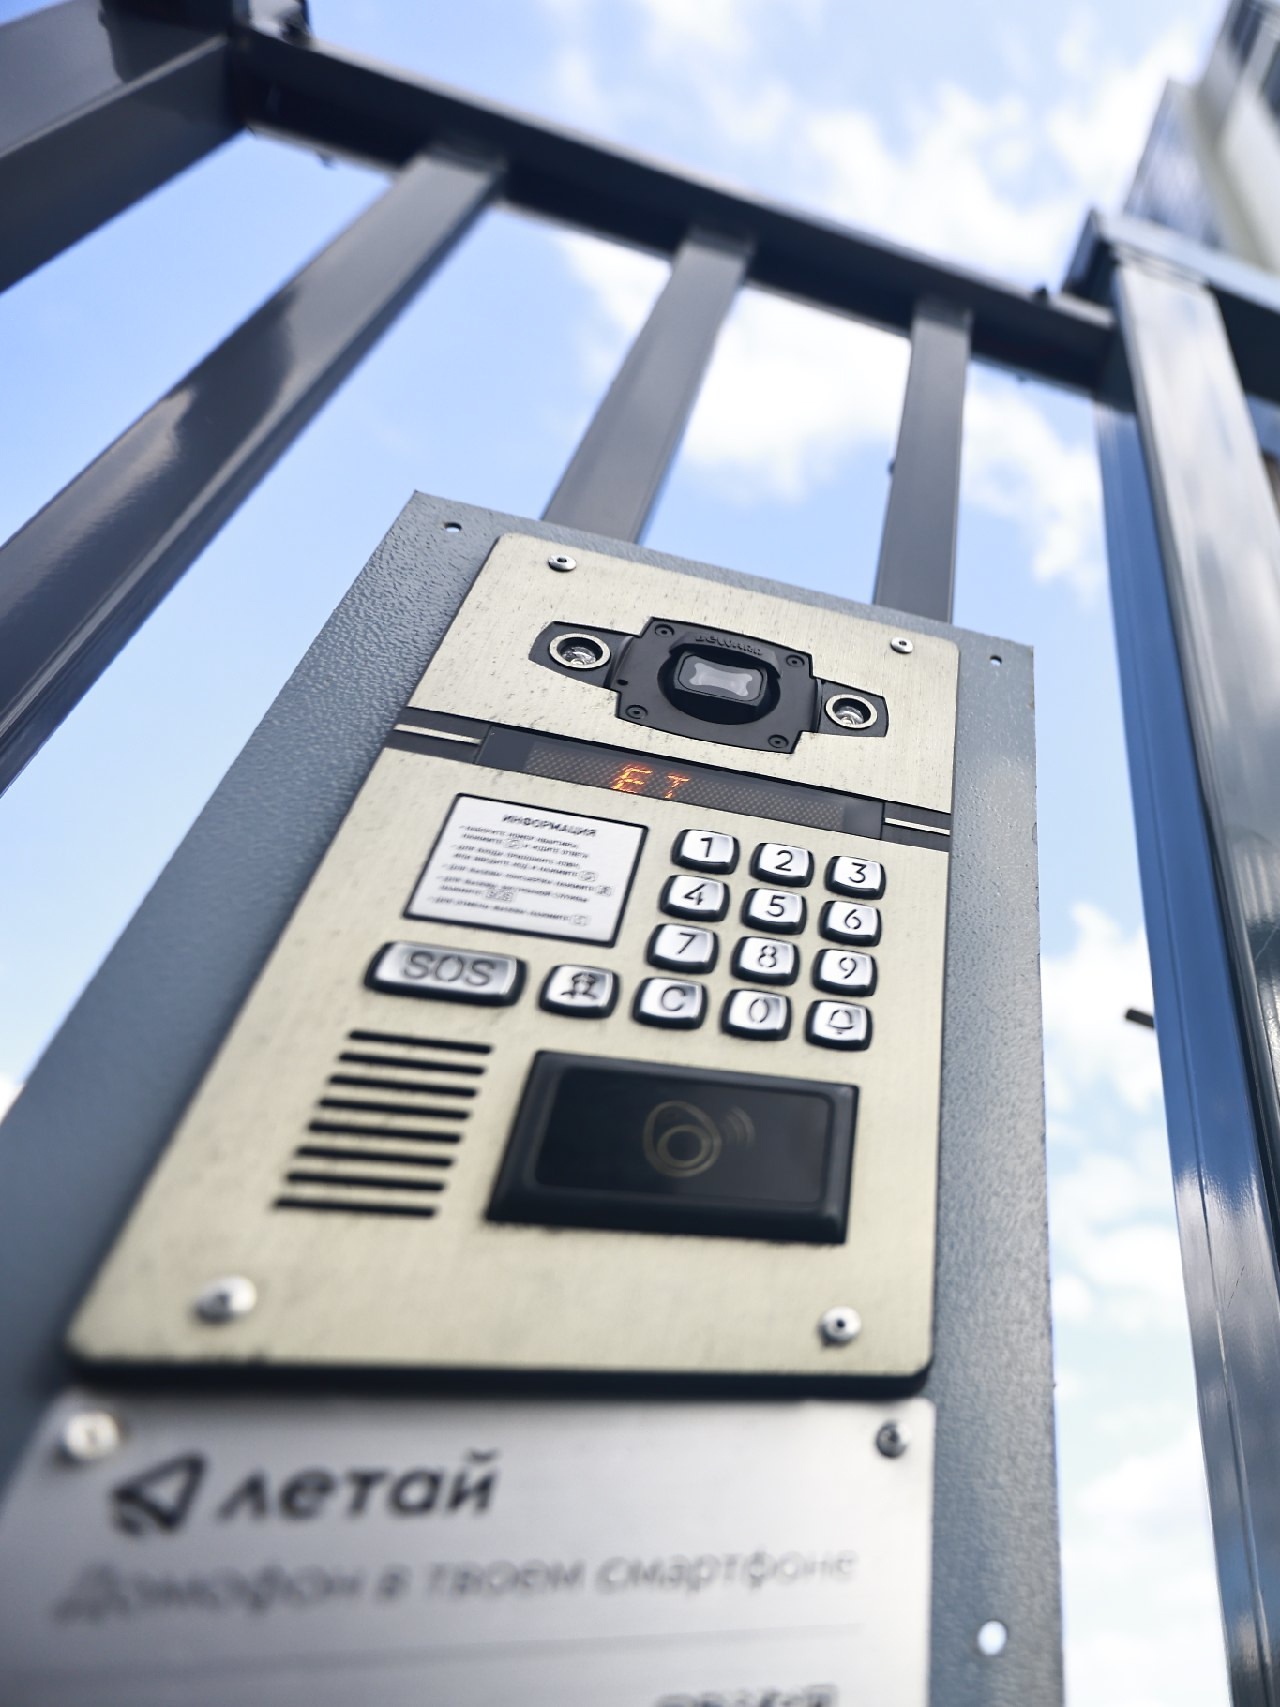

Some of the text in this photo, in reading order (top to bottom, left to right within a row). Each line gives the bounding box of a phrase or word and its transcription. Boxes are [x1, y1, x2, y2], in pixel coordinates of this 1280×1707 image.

[501, 814, 597, 837] ИНФОРМАЦИЯ
[700, 836, 867, 883] 1 2 3
[684, 883, 862, 930] 4 5 6
[677, 932, 857, 979] 7 8 9
[403, 950, 770, 1024] SOS C 0
[217, 1447, 499, 1523] летай
[595, 1547, 859, 1595] смартфоне
